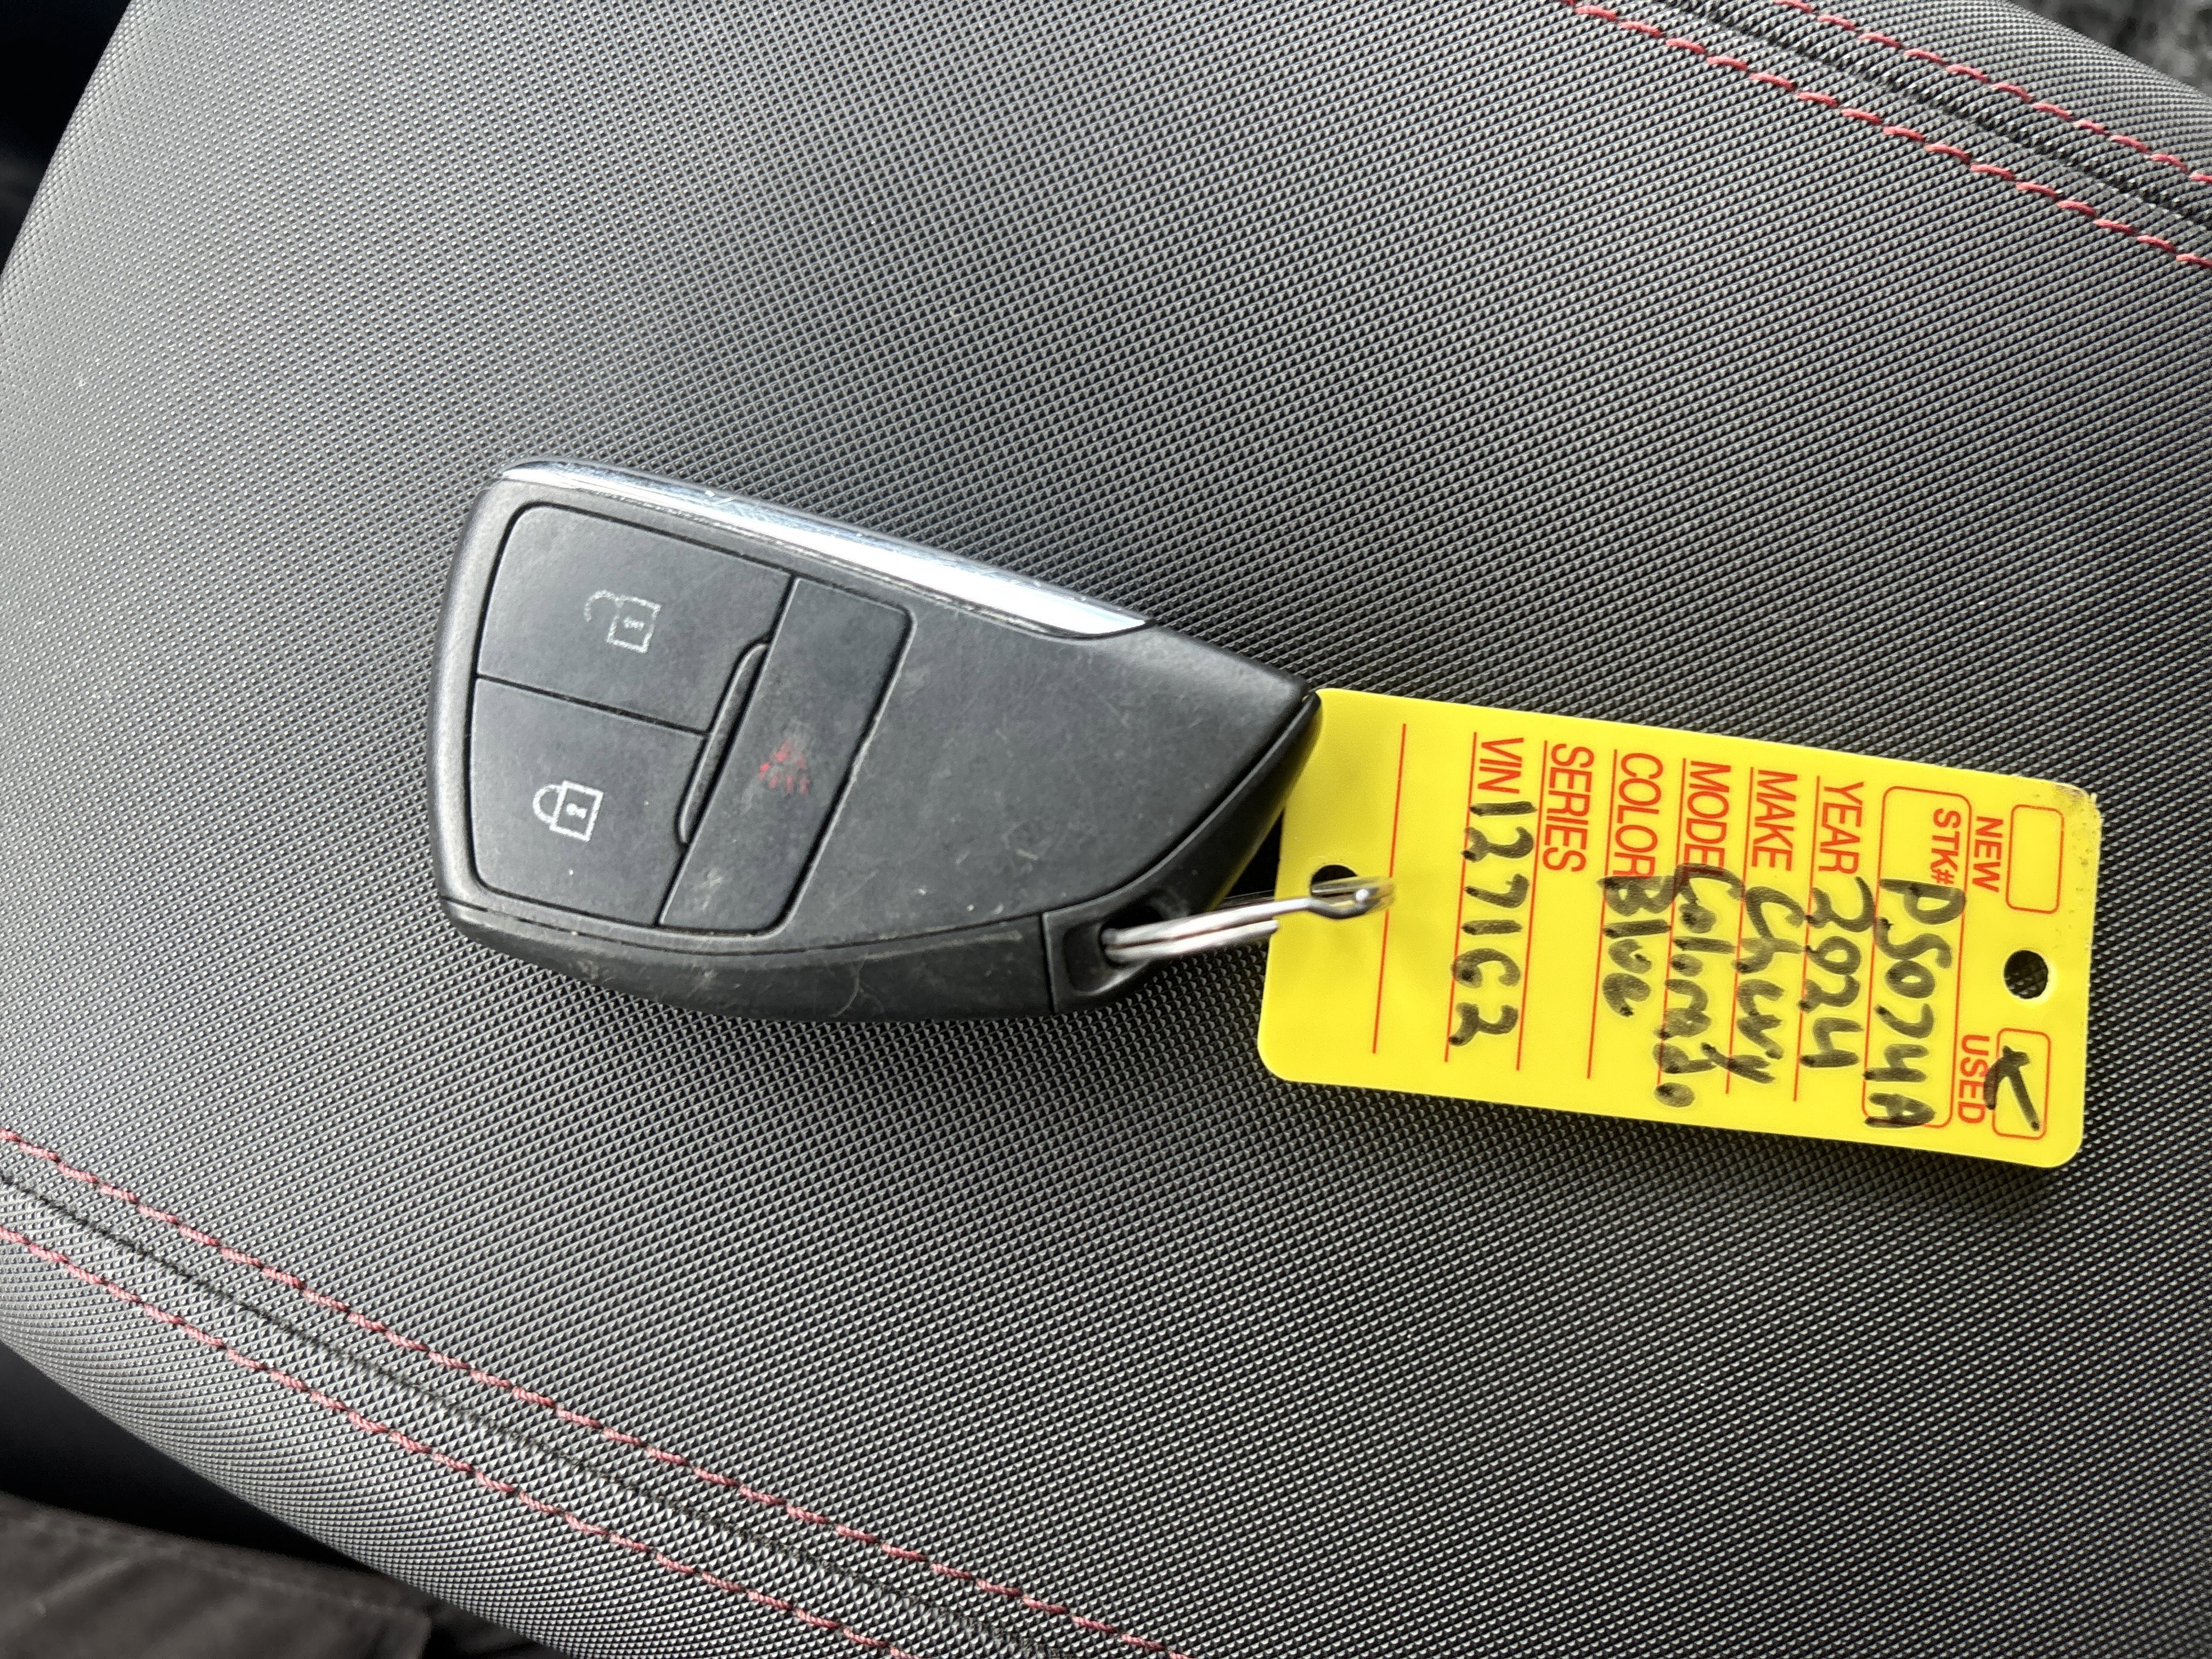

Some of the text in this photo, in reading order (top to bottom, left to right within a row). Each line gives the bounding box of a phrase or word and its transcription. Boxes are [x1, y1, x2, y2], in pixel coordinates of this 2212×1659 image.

[1477, 737, 1524, 794] VIN
[1543, 743, 1595, 872] SERIES
[1612, 753, 1663, 879] COLOR
[1751, 770, 1797, 871] MAKE
[1818, 781, 1864, 874] YEAR
[1929, 808, 1961, 884] STK#
[1972, 816, 2004, 893] NEW
[1449, 800, 1537, 1046] 127162
[1597, 876, 1675, 1018] Blue
[1798, 876, 1877, 1068] 2024
[1701, 885, 1807, 1084] Chevy
[1958, 1034, 1990, 1124] USED
